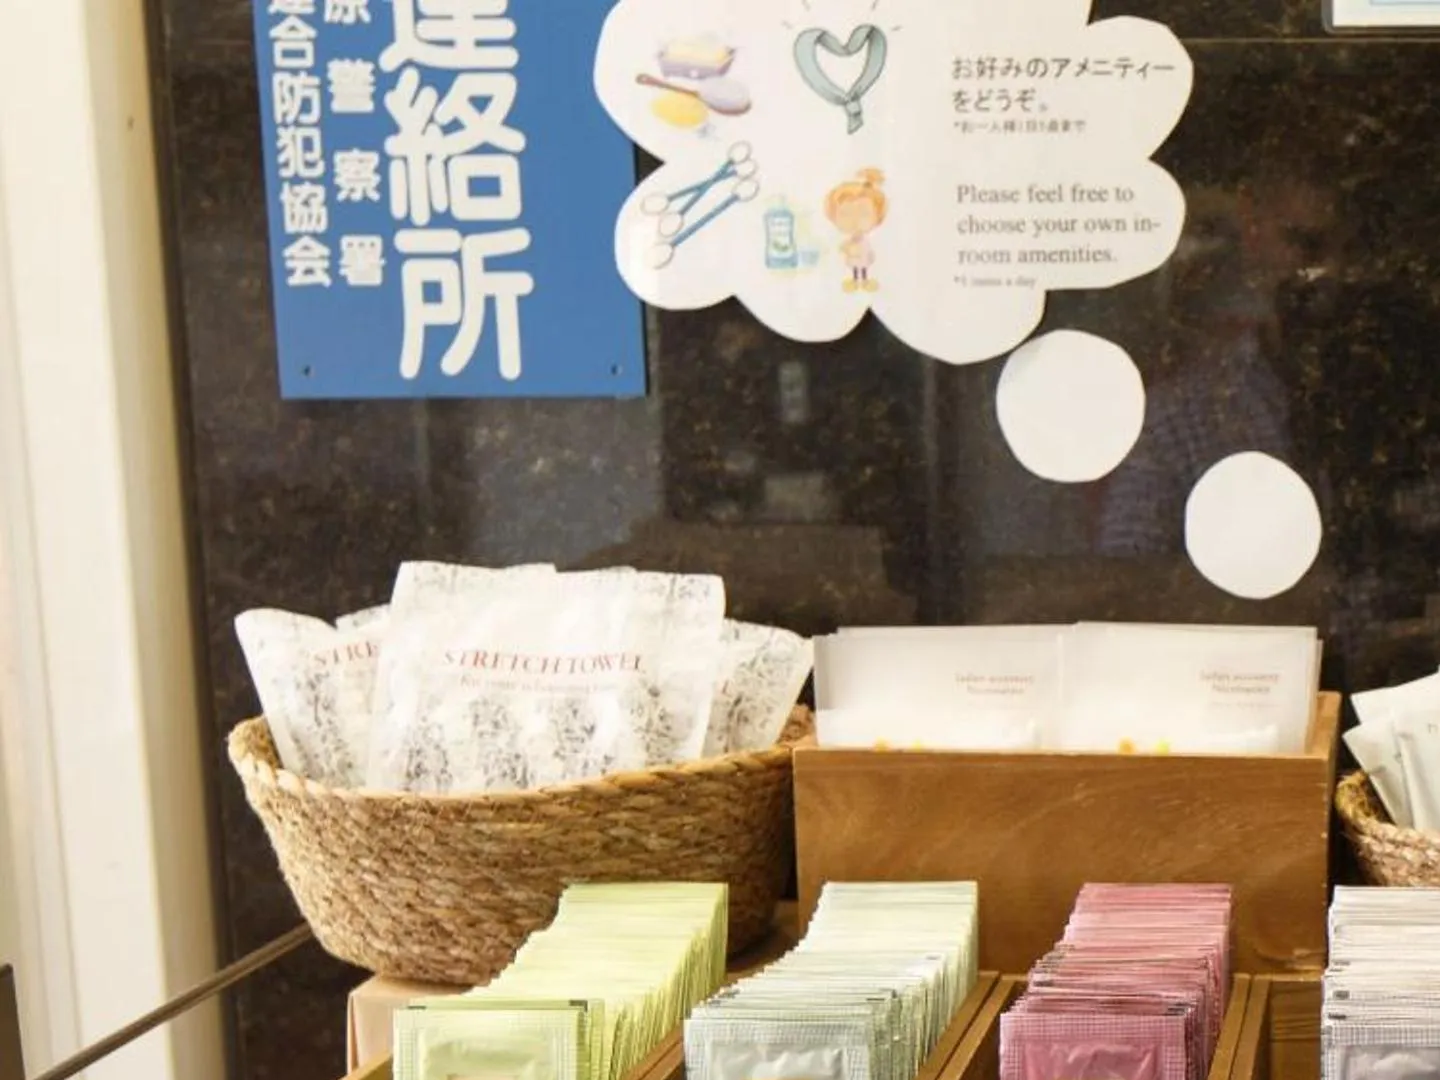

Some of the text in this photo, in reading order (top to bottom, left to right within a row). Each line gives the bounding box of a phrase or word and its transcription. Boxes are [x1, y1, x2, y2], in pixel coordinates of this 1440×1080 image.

[952, 57, 1176, 80] お好みのアメニティー
[952, 88, 1050, 114] をどうぞ。
[267, 0, 332, 288] 合防犯協会
[956, 183, 1135, 203] Please feel free to
[956, 214, 1162, 238] choose your own in-
[957, 243, 1119, 265] room amenities.
